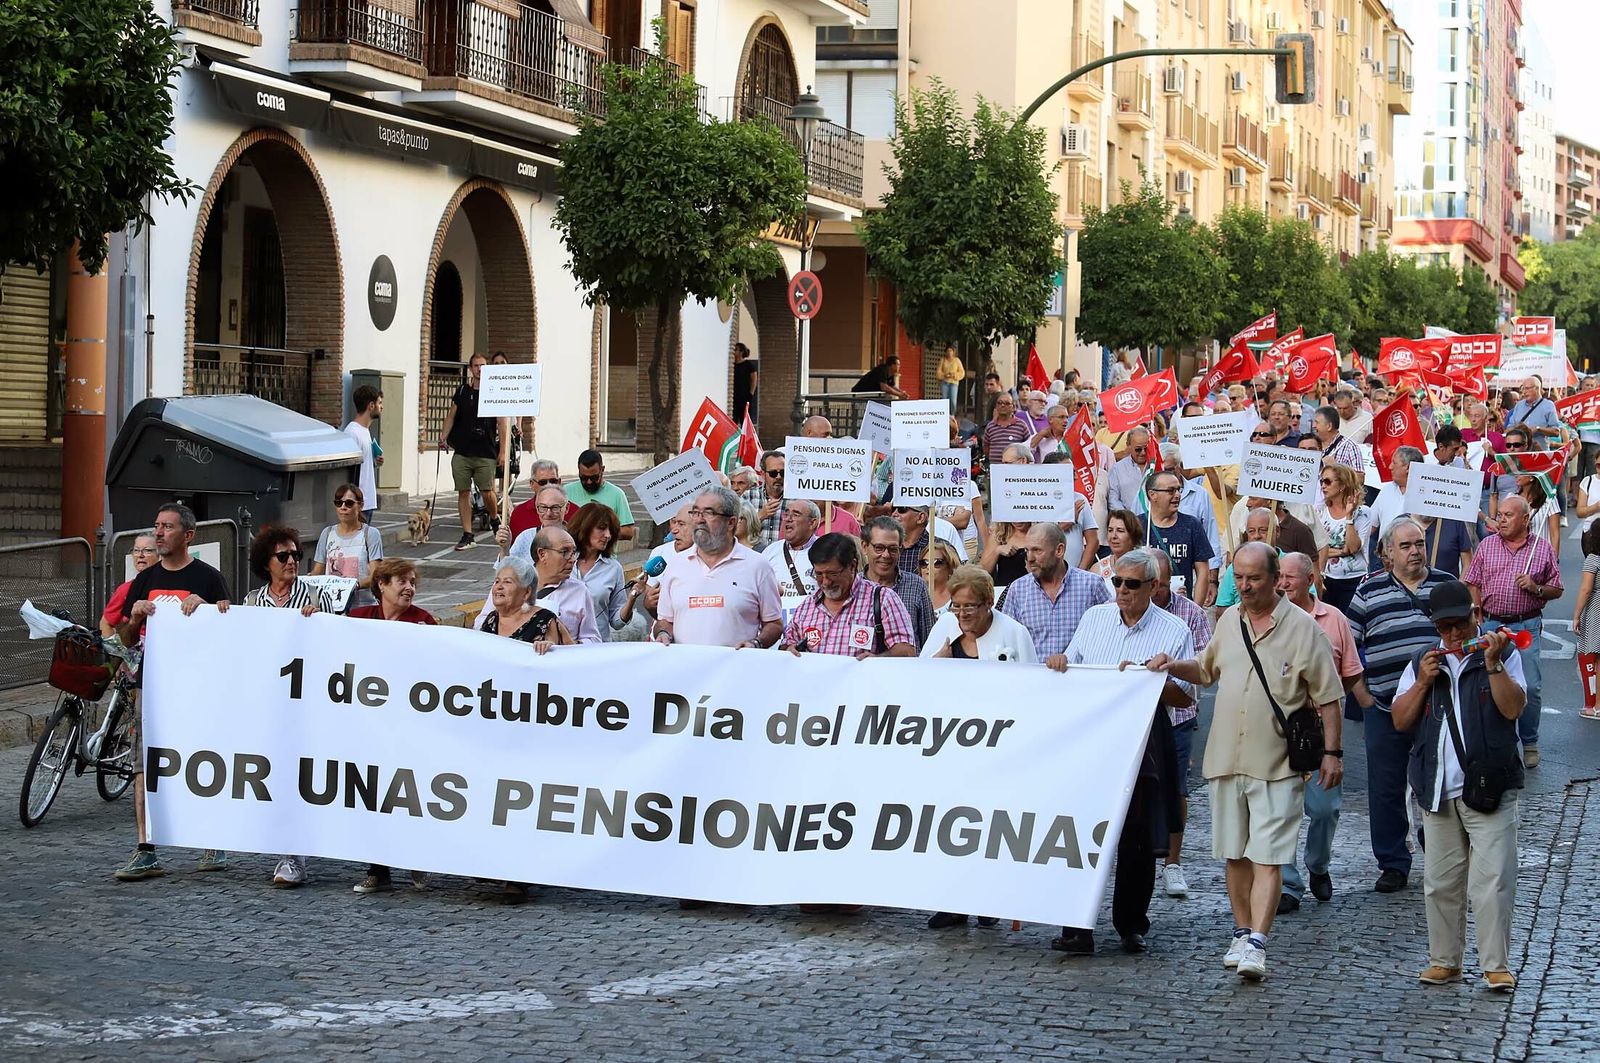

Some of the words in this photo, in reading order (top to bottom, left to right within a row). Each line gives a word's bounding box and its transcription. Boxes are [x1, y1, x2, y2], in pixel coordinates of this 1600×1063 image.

[256, 90, 286, 112] coma
[378, 124, 430, 150] tapas&punto
[517, 161, 538, 178] coma
[374, 282, 392, 297] coma
[1394, 350, 1410, 360] UGT
[1118, 390, 1138, 401] UGT
[793, 445, 835, 454] PENSIONES
[836, 447, 866, 456] DIGNAS
[1250, 450, 1288, 460] PENSIONES
[1288, 455, 1315, 464] DIGNAS
[906, 457, 920, 465] NO
[936, 458, 960, 466] ROBO
[646, 470, 678, 490] JUBILACION
[678, 461, 696, 473] DIGNA
[798, 478, 856, 492] MUJERES
[900, 486, 964, 497] PENSIONES
[1250, 478, 1304, 495] MUJERES
[655, 494, 684, 511] EMPLEADAS
[280, 657, 304, 700] 1
[328, 663, 390, 707] de
[408, 678, 630, 731] octubre
[652, 691, 744, 741] Día
[766, 702, 846, 748] del
[854, 704, 1015, 757] Mayor
[146, 746, 272, 802] POR
[298, 757, 469, 822] UNAS
[492, 778, 856, 852] PENSIONES
